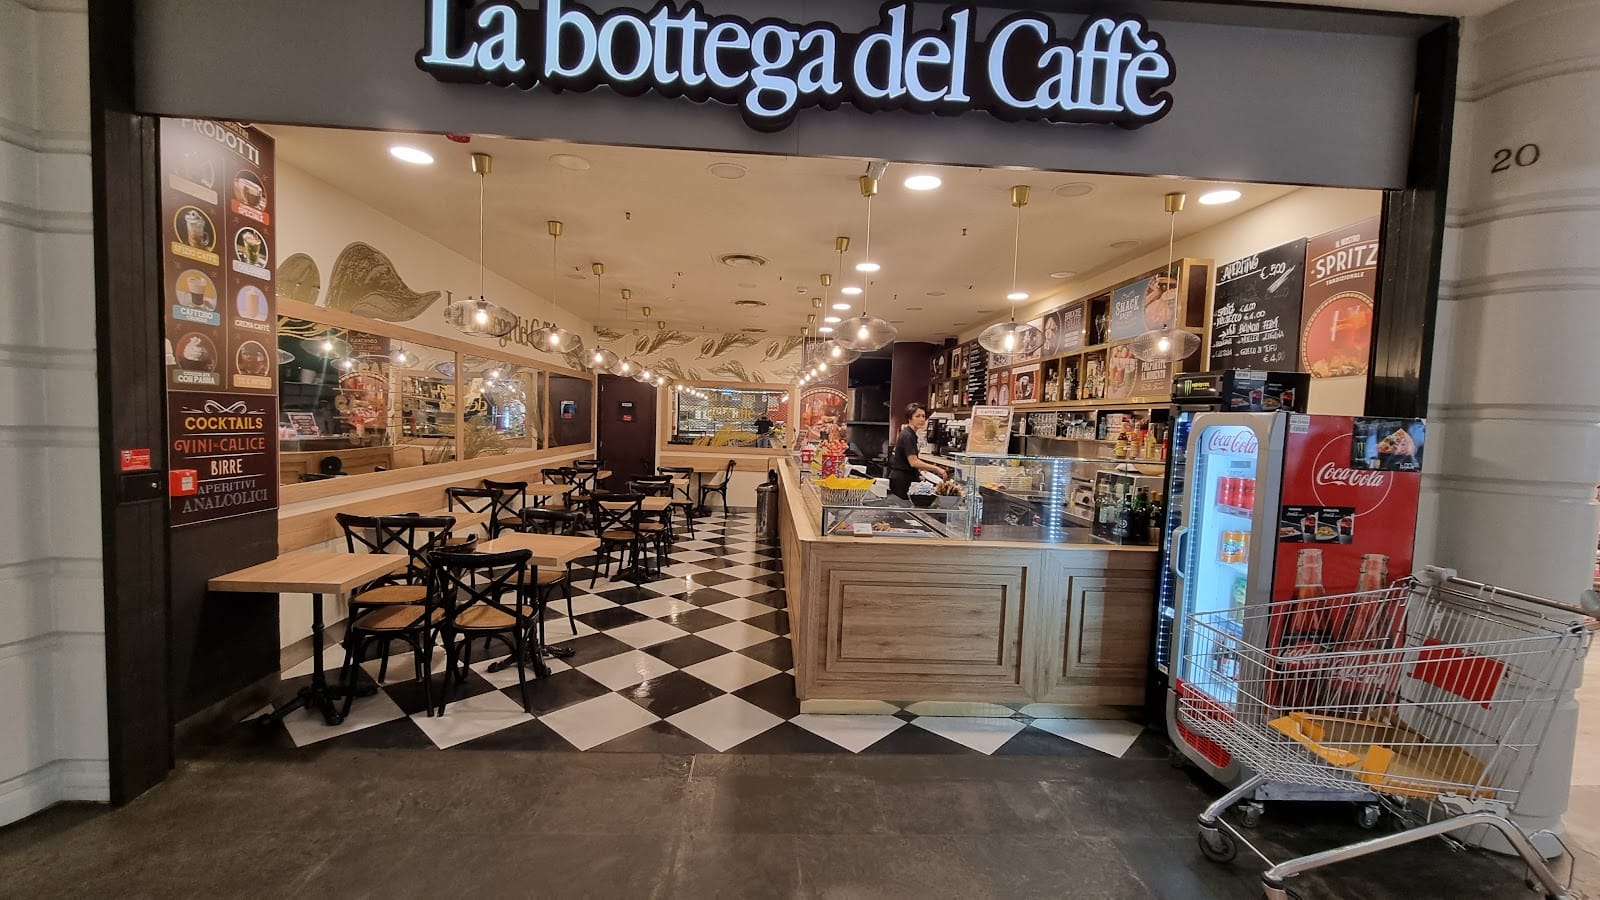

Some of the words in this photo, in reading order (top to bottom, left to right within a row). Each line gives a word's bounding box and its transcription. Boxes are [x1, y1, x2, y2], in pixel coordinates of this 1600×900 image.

[422, 0, 525, 72] La
[544, 0, 843, 118] bottega
[853, 8, 971, 103] del
[988, 17, 1171, 118] Caffè
[181, 118, 261, 166] PRODOTTI
[1491, 143, 1540, 174] 20
[1316, 243, 1379, 279] SPRITZ
[184, 417, 263, 430] COCKTAILS
[210, 458, 243, 476] BIRRE
[182, 488, 268, 514] ANALCOLICI
[198, 479, 256, 496] APERITIVI
